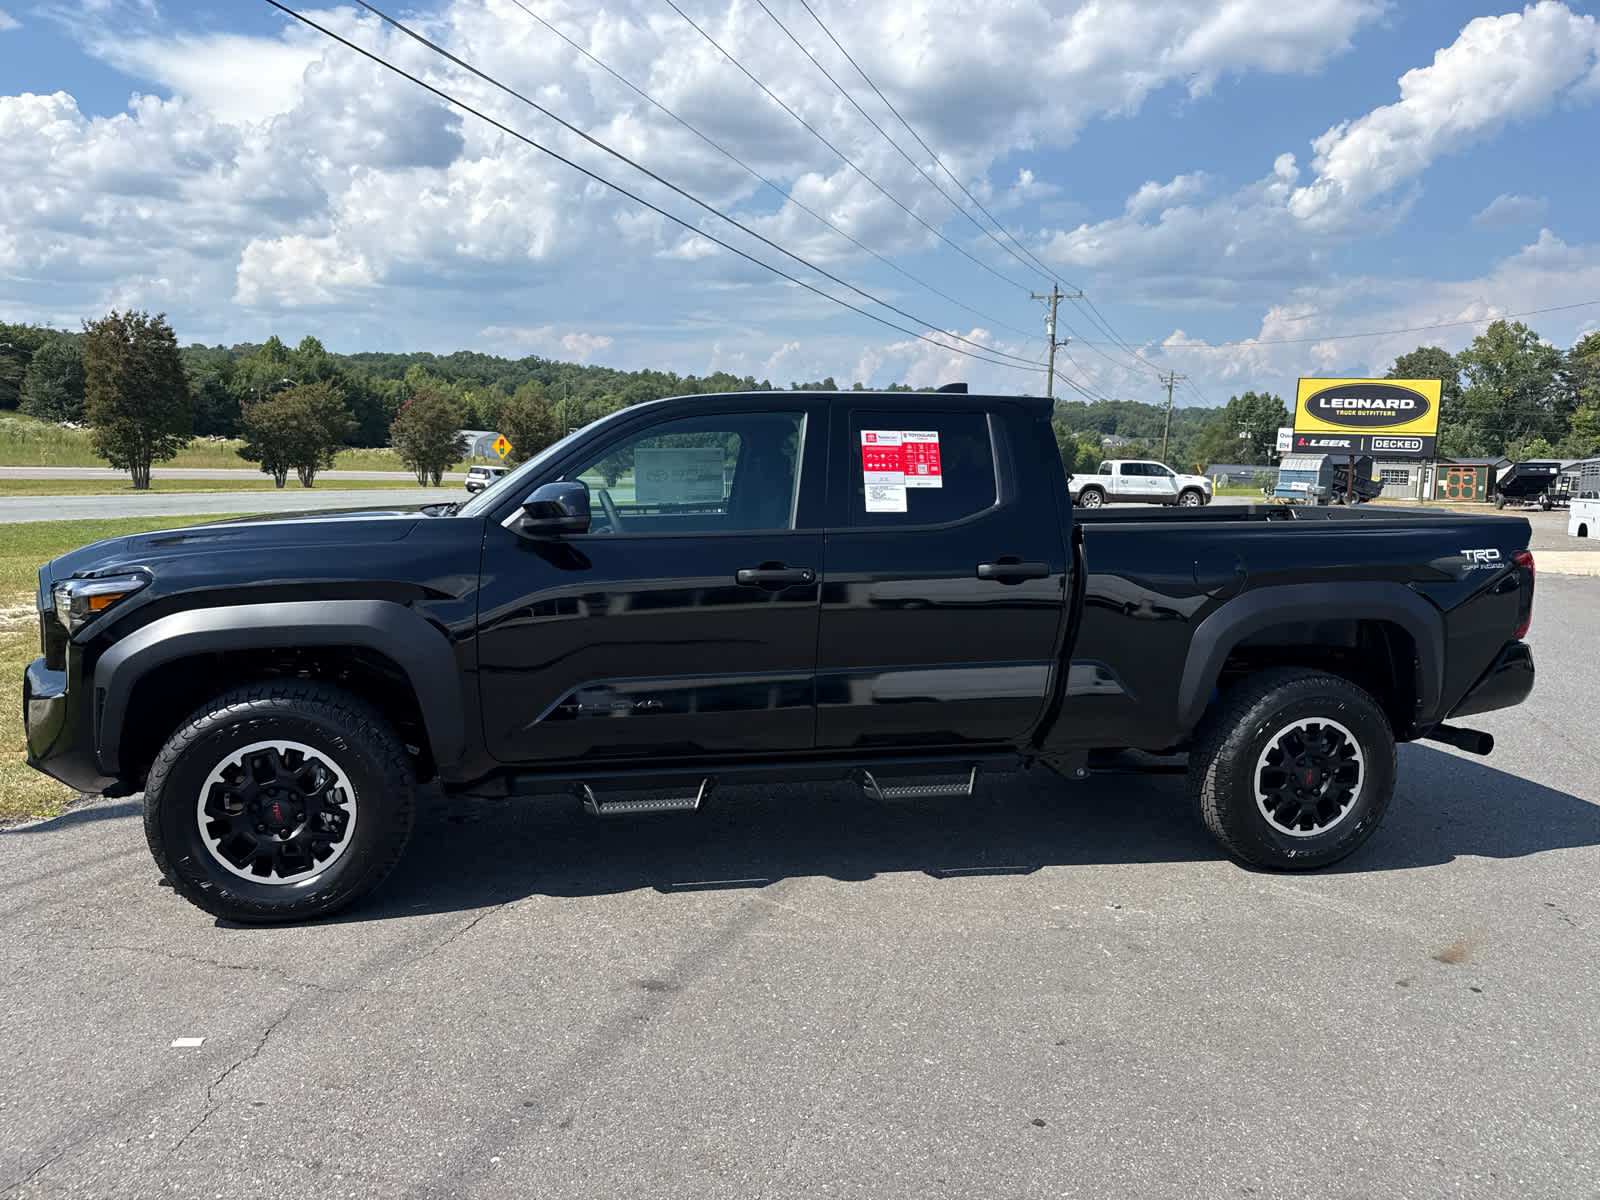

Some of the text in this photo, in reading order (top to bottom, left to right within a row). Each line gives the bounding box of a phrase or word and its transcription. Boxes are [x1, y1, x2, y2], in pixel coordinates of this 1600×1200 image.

[1319, 398, 1415, 408] LEONARD
[1309, 439, 1351, 448] LEER
[1375, 440, 1419, 449] DECKED
[1461, 549, 1499, 563] TRD
